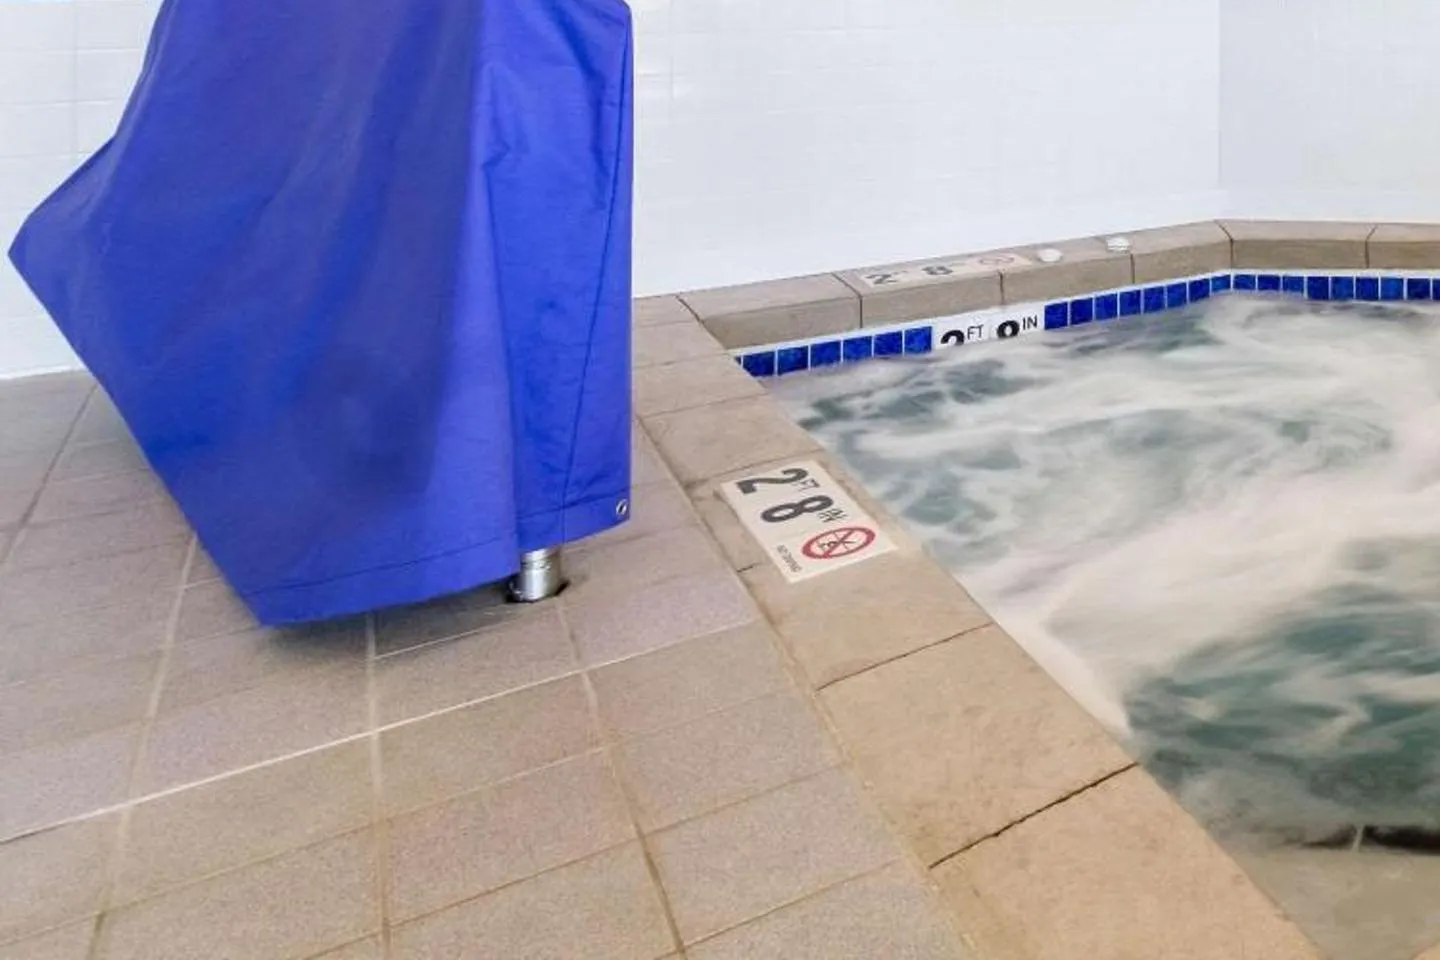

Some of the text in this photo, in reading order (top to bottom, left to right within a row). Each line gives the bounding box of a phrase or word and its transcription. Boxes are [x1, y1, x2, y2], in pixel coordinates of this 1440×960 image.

[967, 324, 984, 340] FT
[1022, 315, 1038, 331] IN
[736, 468, 808, 495] 2
[761, 495, 834, 522] 8
